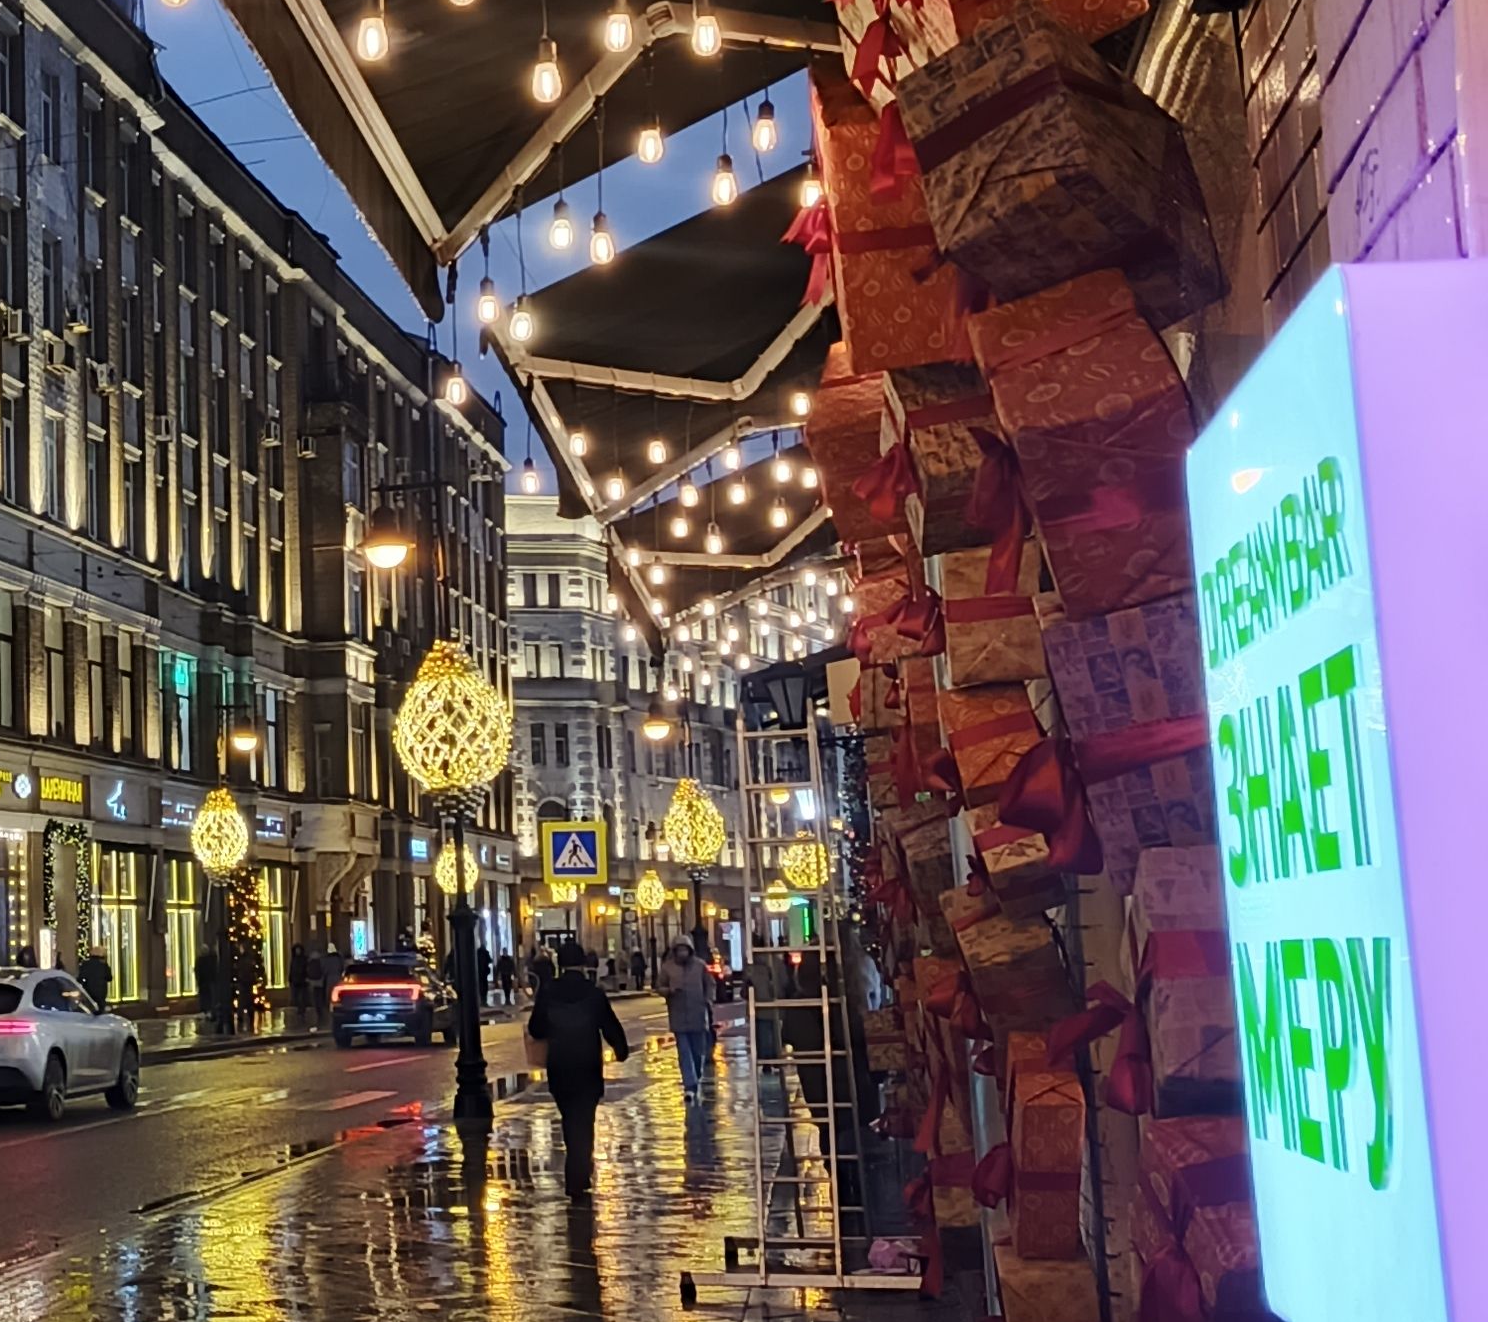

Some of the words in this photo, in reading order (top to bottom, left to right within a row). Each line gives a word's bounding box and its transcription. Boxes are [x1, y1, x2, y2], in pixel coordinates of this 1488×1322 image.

[1201, 456, 1353, 670] DREAMBAR
[1218, 643, 1373, 889] ЗНАЕТ
[1235, 936, 1394, 1191] МЕРУ
